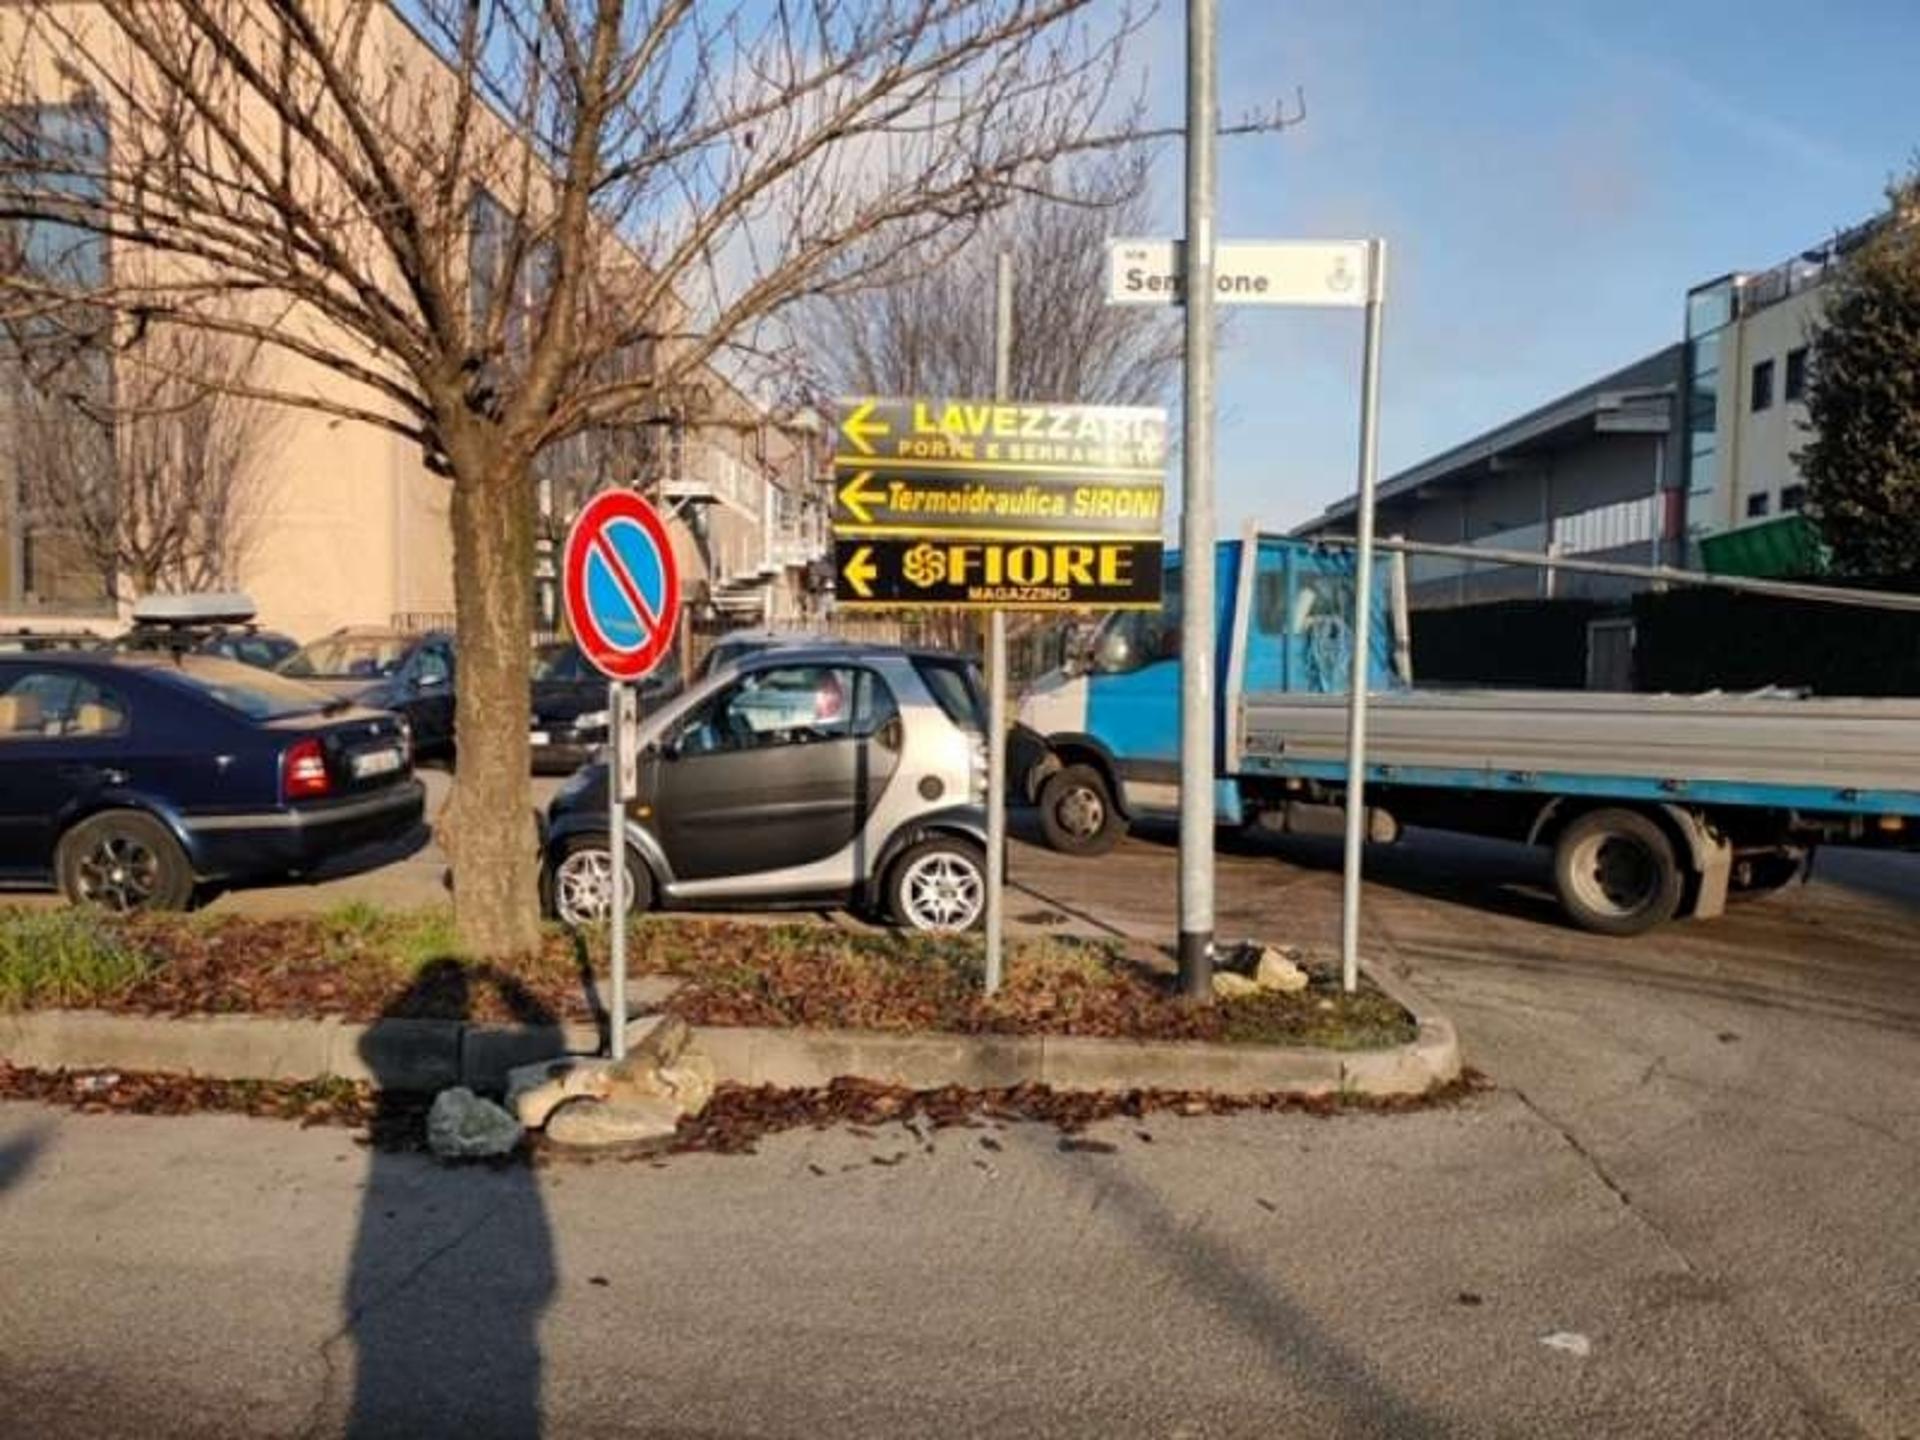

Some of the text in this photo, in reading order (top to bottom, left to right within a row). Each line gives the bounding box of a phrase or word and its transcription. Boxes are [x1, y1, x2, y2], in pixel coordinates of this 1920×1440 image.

[1125, 267, 1269, 292] Semone
[898, 440, 975, 460] PORTE
[986, 442, 1000, 460] E
[888, 481, 1159, 519] Termoidraulica SIRONI
[948, 545, 1133, 586] FIORE
[967, 587, 1071, 601] MAGAZZINO
